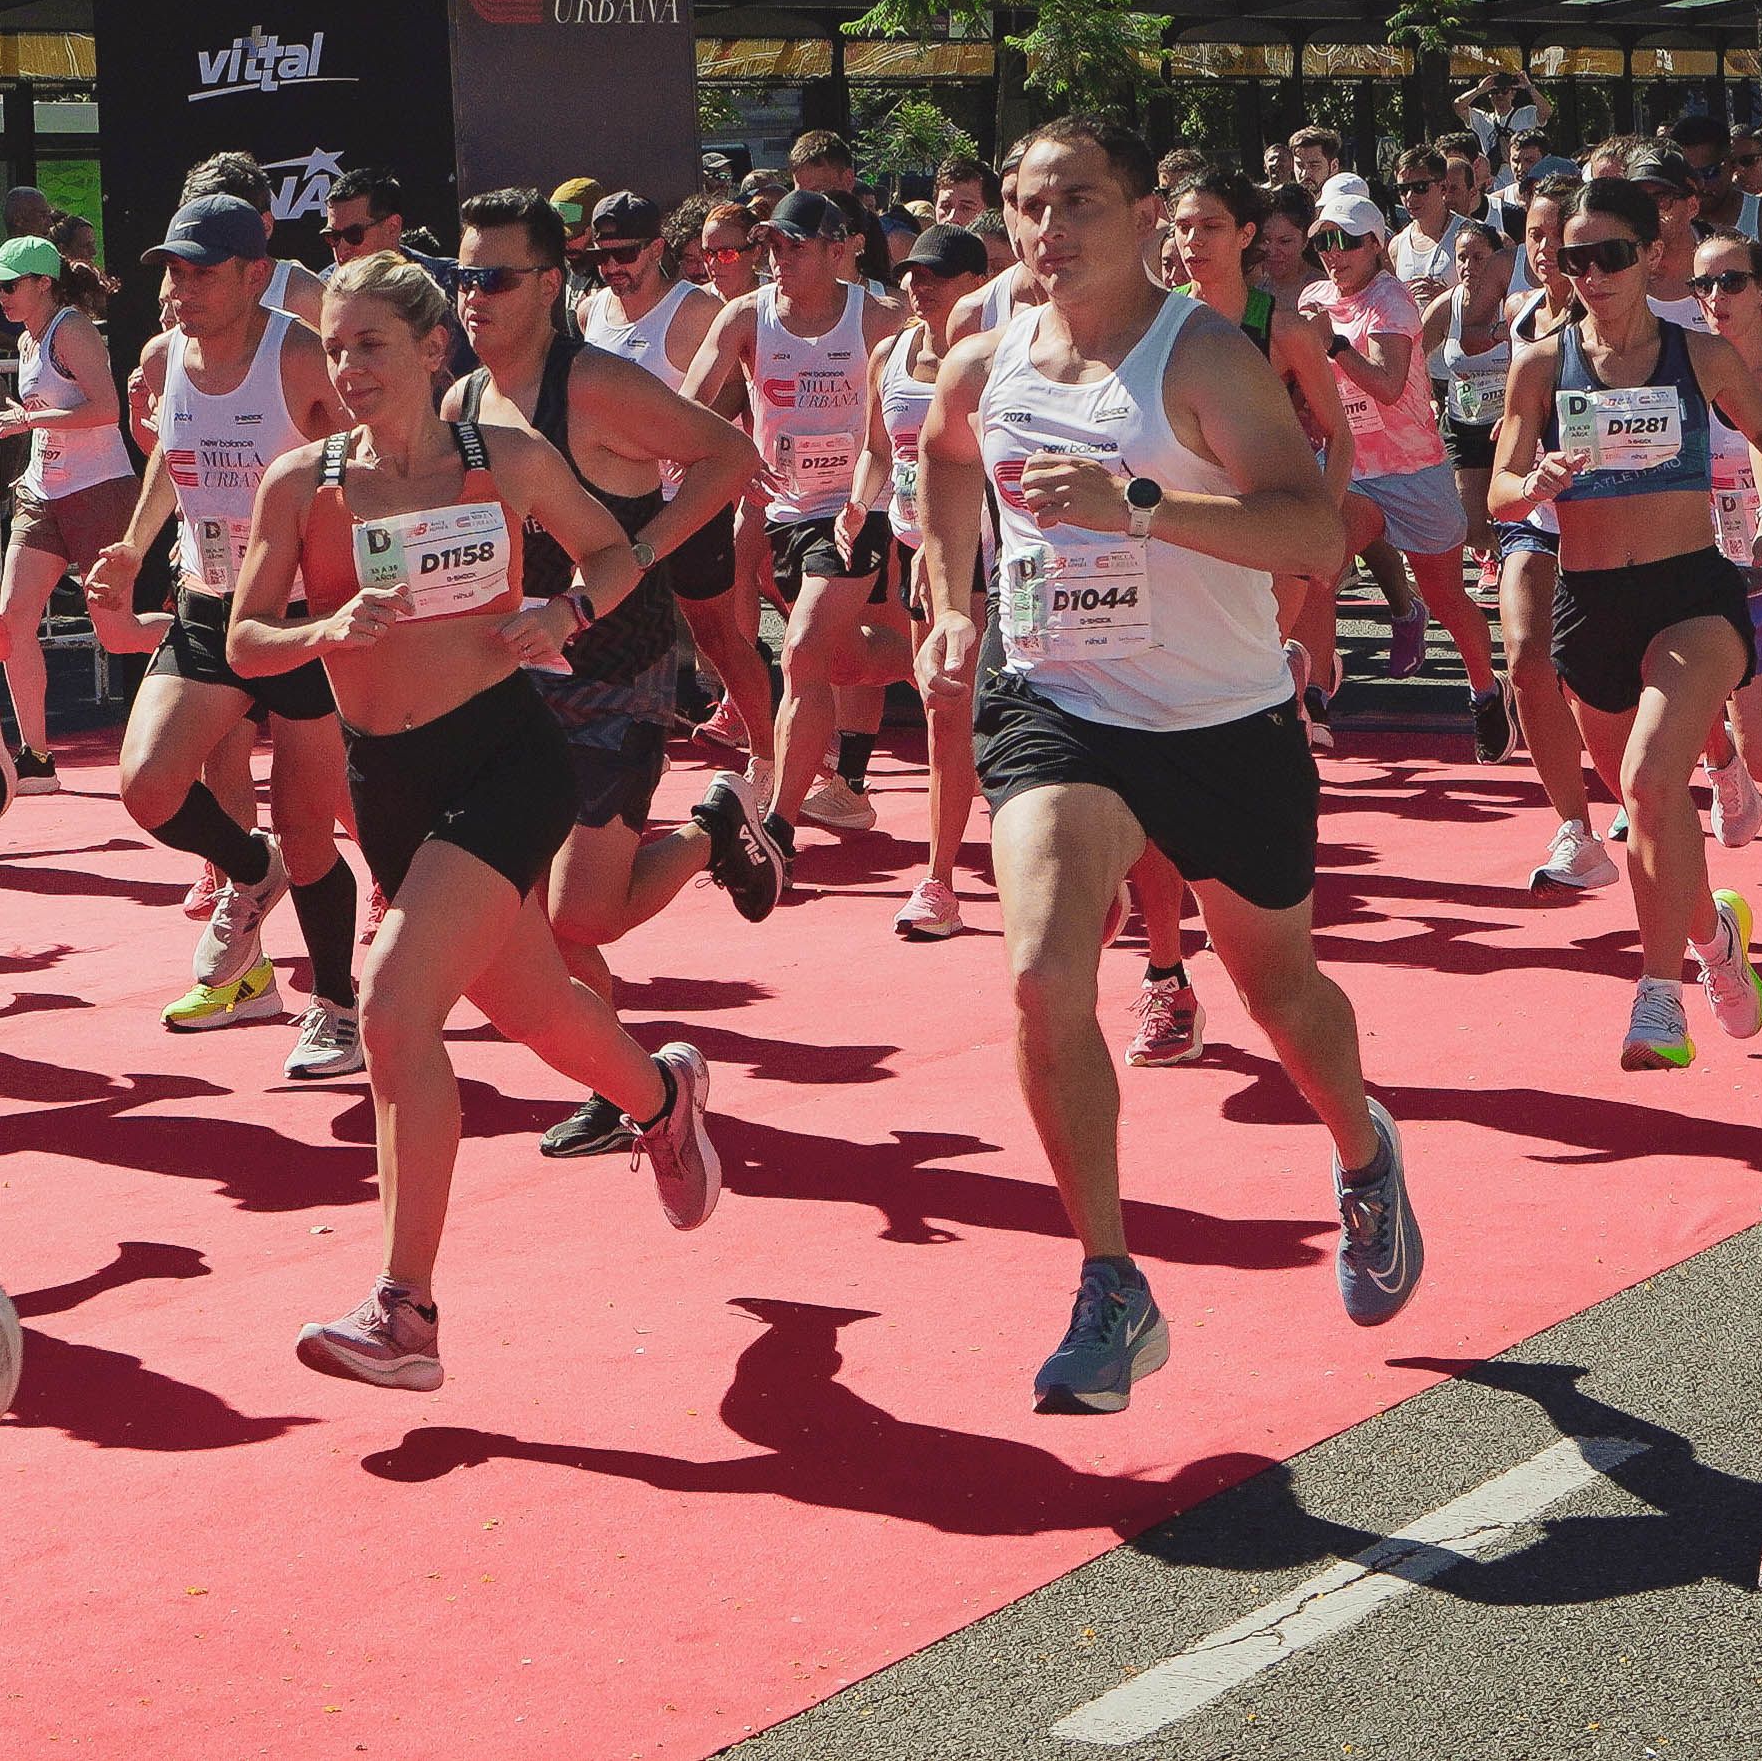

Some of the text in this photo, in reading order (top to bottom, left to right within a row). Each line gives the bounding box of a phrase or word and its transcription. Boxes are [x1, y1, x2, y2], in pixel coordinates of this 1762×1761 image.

[798, 378, 853, 394] MILLA
[797, 393, 860, 409] URBANA
[1568, 396, 1588, 416] D
[1002, 411, 1032, 424] 2024
[1607, 416, 1669, 436] D1281
[1042, 441, 1119, 455] new balance
[201, 450, 266, 468] MILLA
[801, 455, 849, 471] D1225
[203, 470, 264, 489] URBAN
[366, 528, 392, 555] D
[420, 540, 496, 575] D1158
[1052, 585, 1139, 612] D1044
[739, 823, 767, 867] FILA
